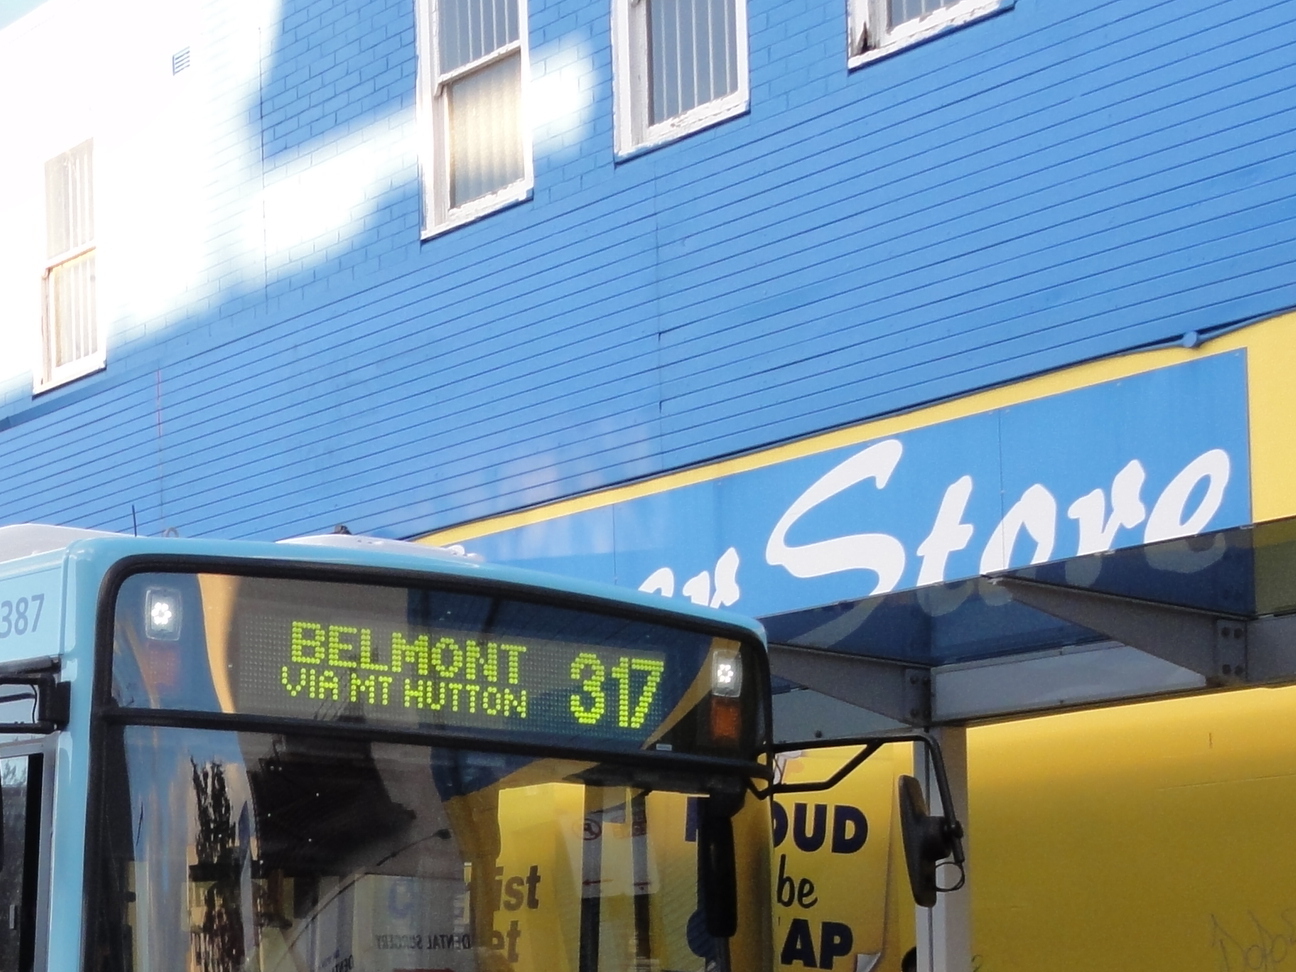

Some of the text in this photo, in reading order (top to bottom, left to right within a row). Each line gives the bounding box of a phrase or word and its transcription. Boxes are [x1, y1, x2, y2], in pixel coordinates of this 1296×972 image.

[765, 439, 1231, 648] Store
[291, 621, 527, 685] BELMONT
[281, 666, 527, 719] VIA MT HUTTON
[569, 652, 665, 729] 317
[777, 853, 819, 909] be
